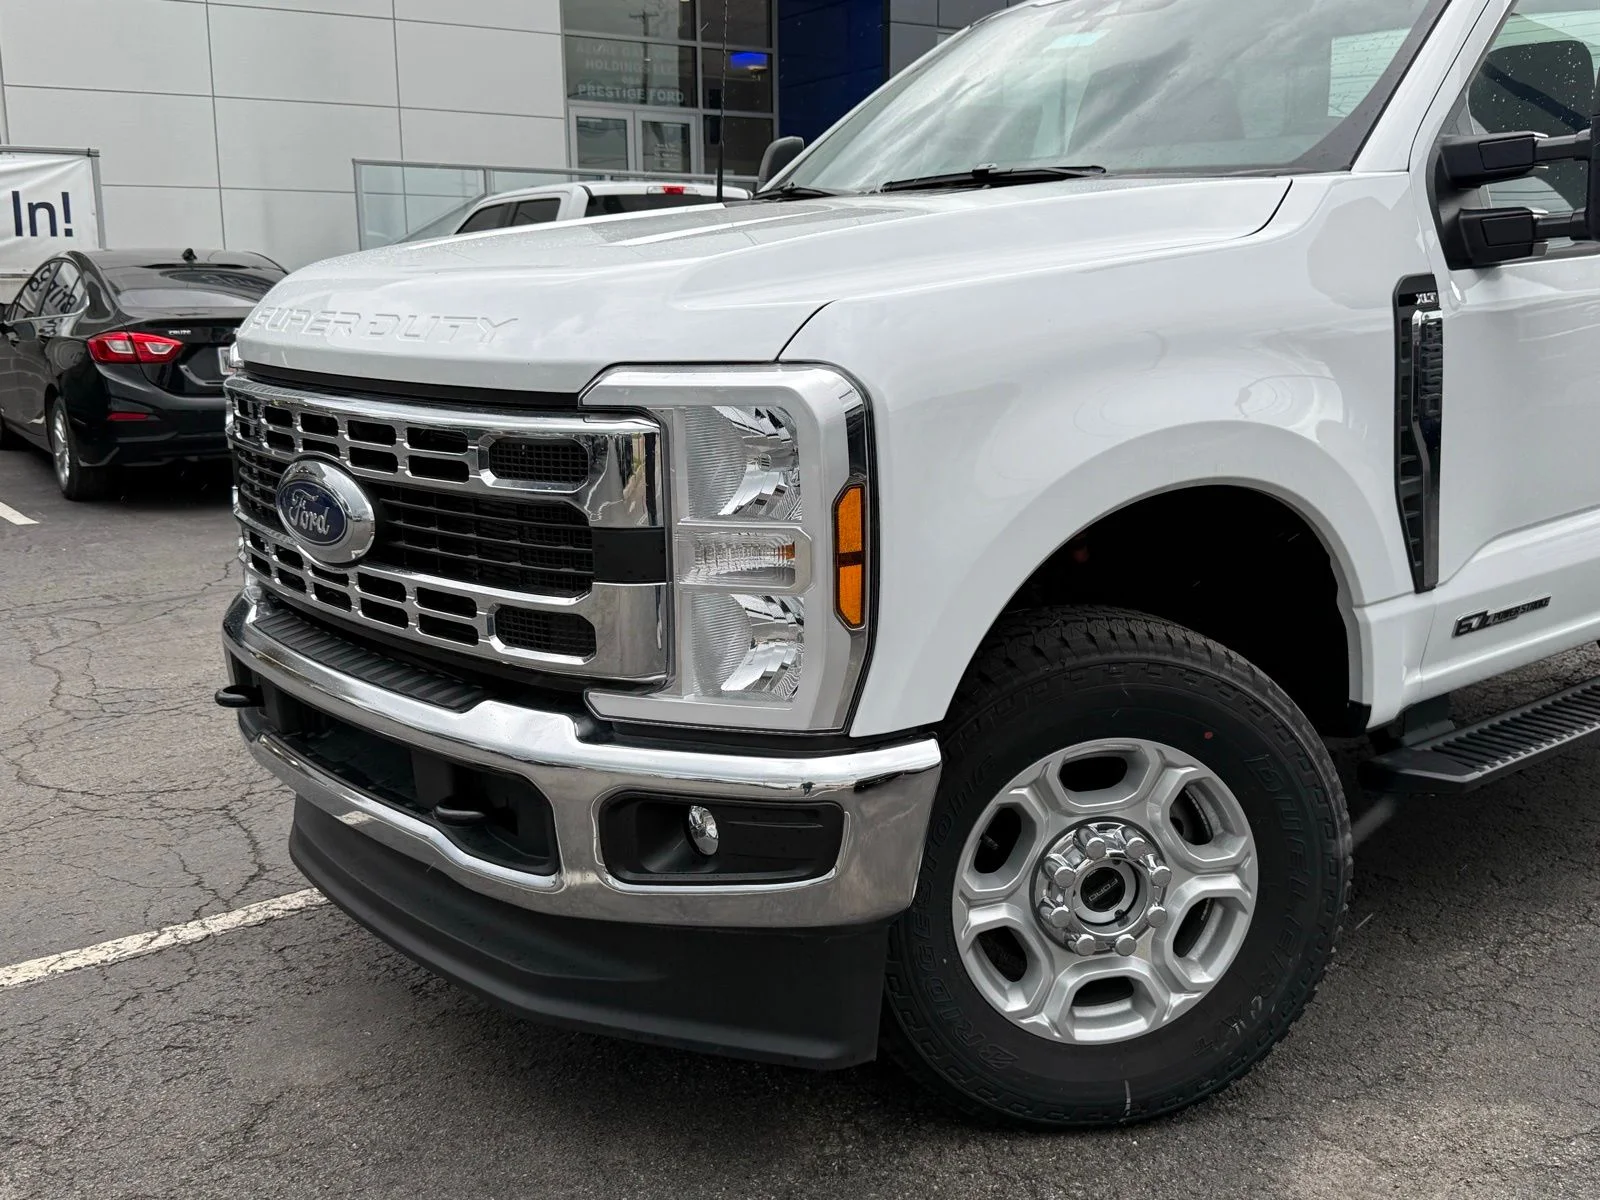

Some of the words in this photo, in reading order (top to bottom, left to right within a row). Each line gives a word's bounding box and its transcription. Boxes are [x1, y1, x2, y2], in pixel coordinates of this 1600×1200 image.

[577, 83, 645, 101] PRESTIGE
[647, 87, 685, 104] FORD
[11, 190, 74, 238] In!
[1415, 292, 1437, 304] XLT
[249, 305, 362, 338] SUPER
[361, 313, 519, 345] DUTY
[288, 488, 330, 535] Ford
[1088, 877, 1119, 902] FORD
